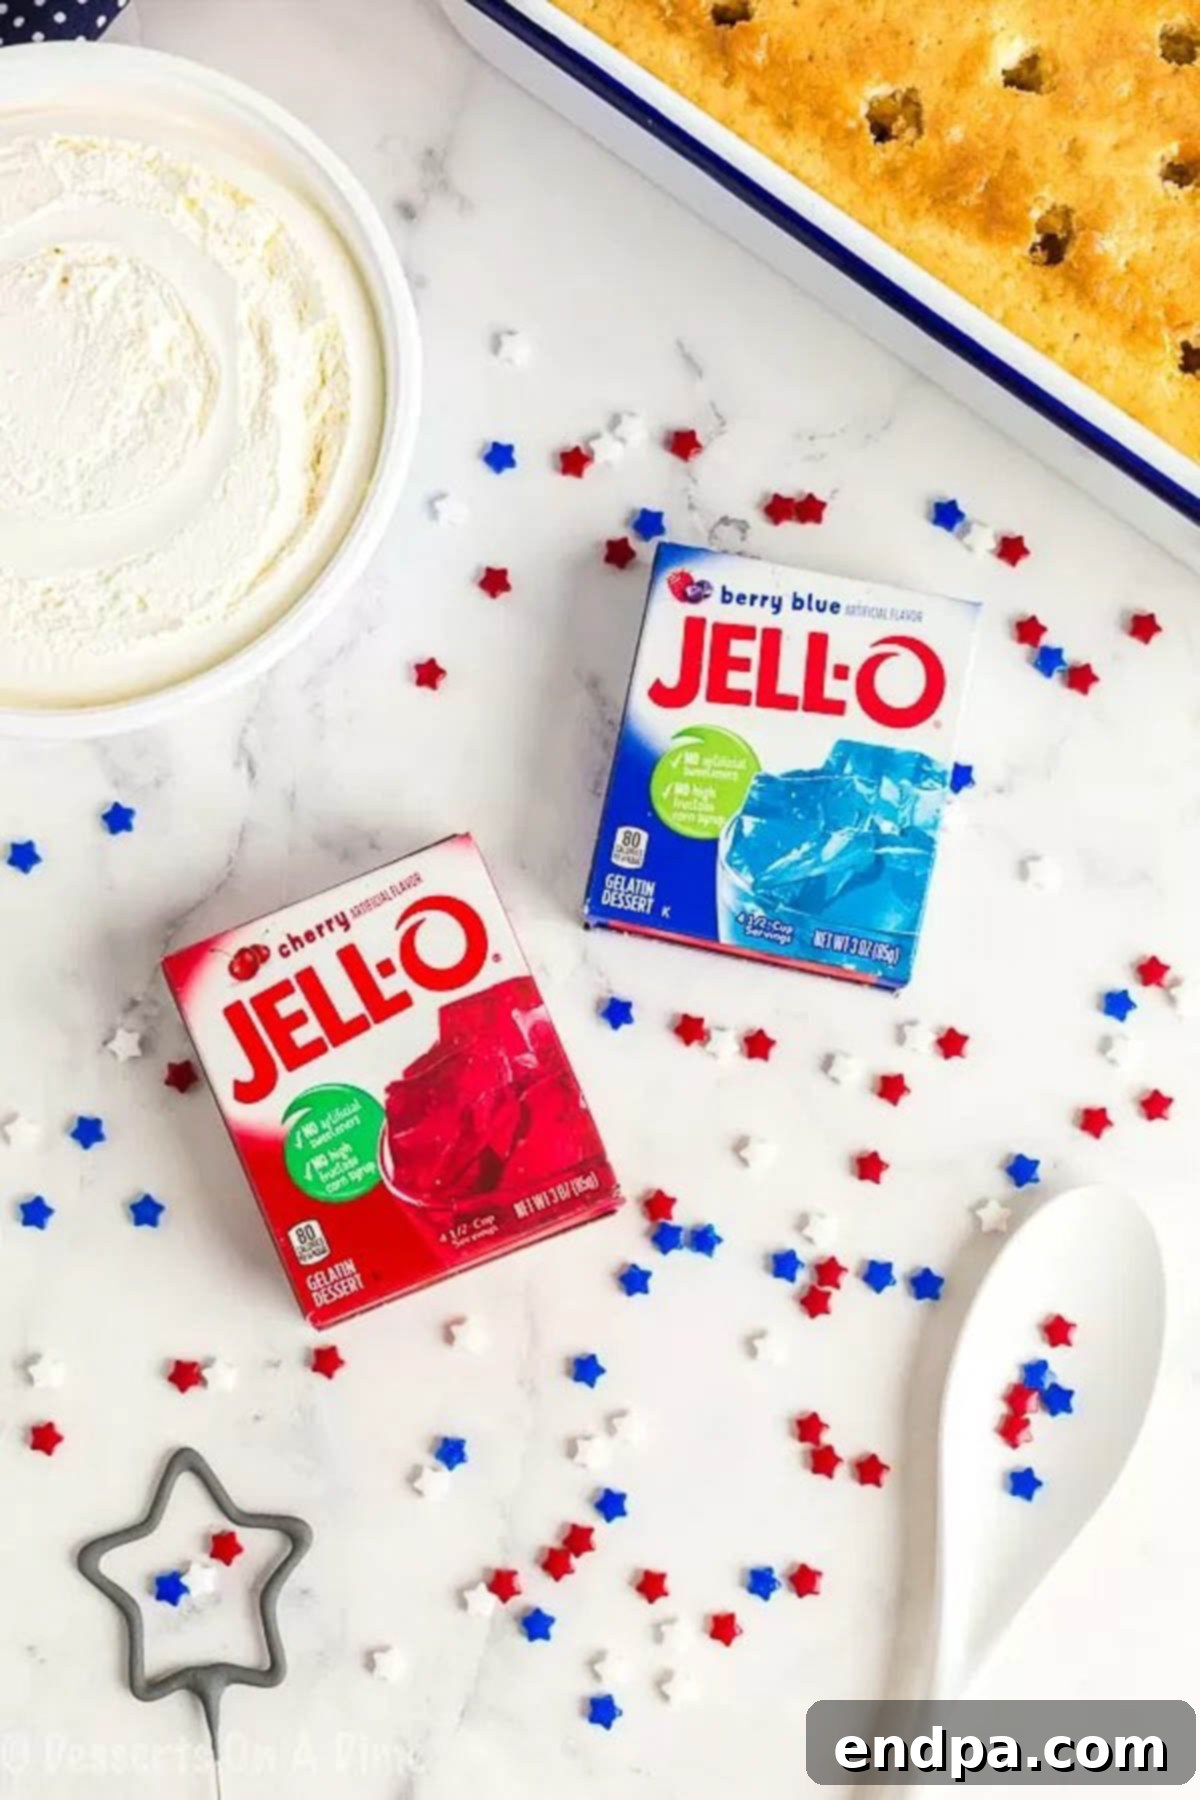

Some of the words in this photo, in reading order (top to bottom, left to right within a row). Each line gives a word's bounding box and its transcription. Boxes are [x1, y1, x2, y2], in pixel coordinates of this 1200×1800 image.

[720, 585, 783, 615] berry
[791, 592, 841, 614] blue
[647, 616, 946, 729] JELL-O
[621, 829, 642, 848] 80
[605, 873, 656, 897] GELATIN
[601, 889, 655, 914] DESSERT
[278, 910, 351, 958] cherry
[813, 930, 832, 948] NET
[223, 895, 488, 1104] JELL-O
[301, 1120, 319, 1139] NO
[295, 1223, 316, 1244] 80
[306, 1258, 356, 1291] GELATIN
[311, 1273, 364, 1308] DESSERT
